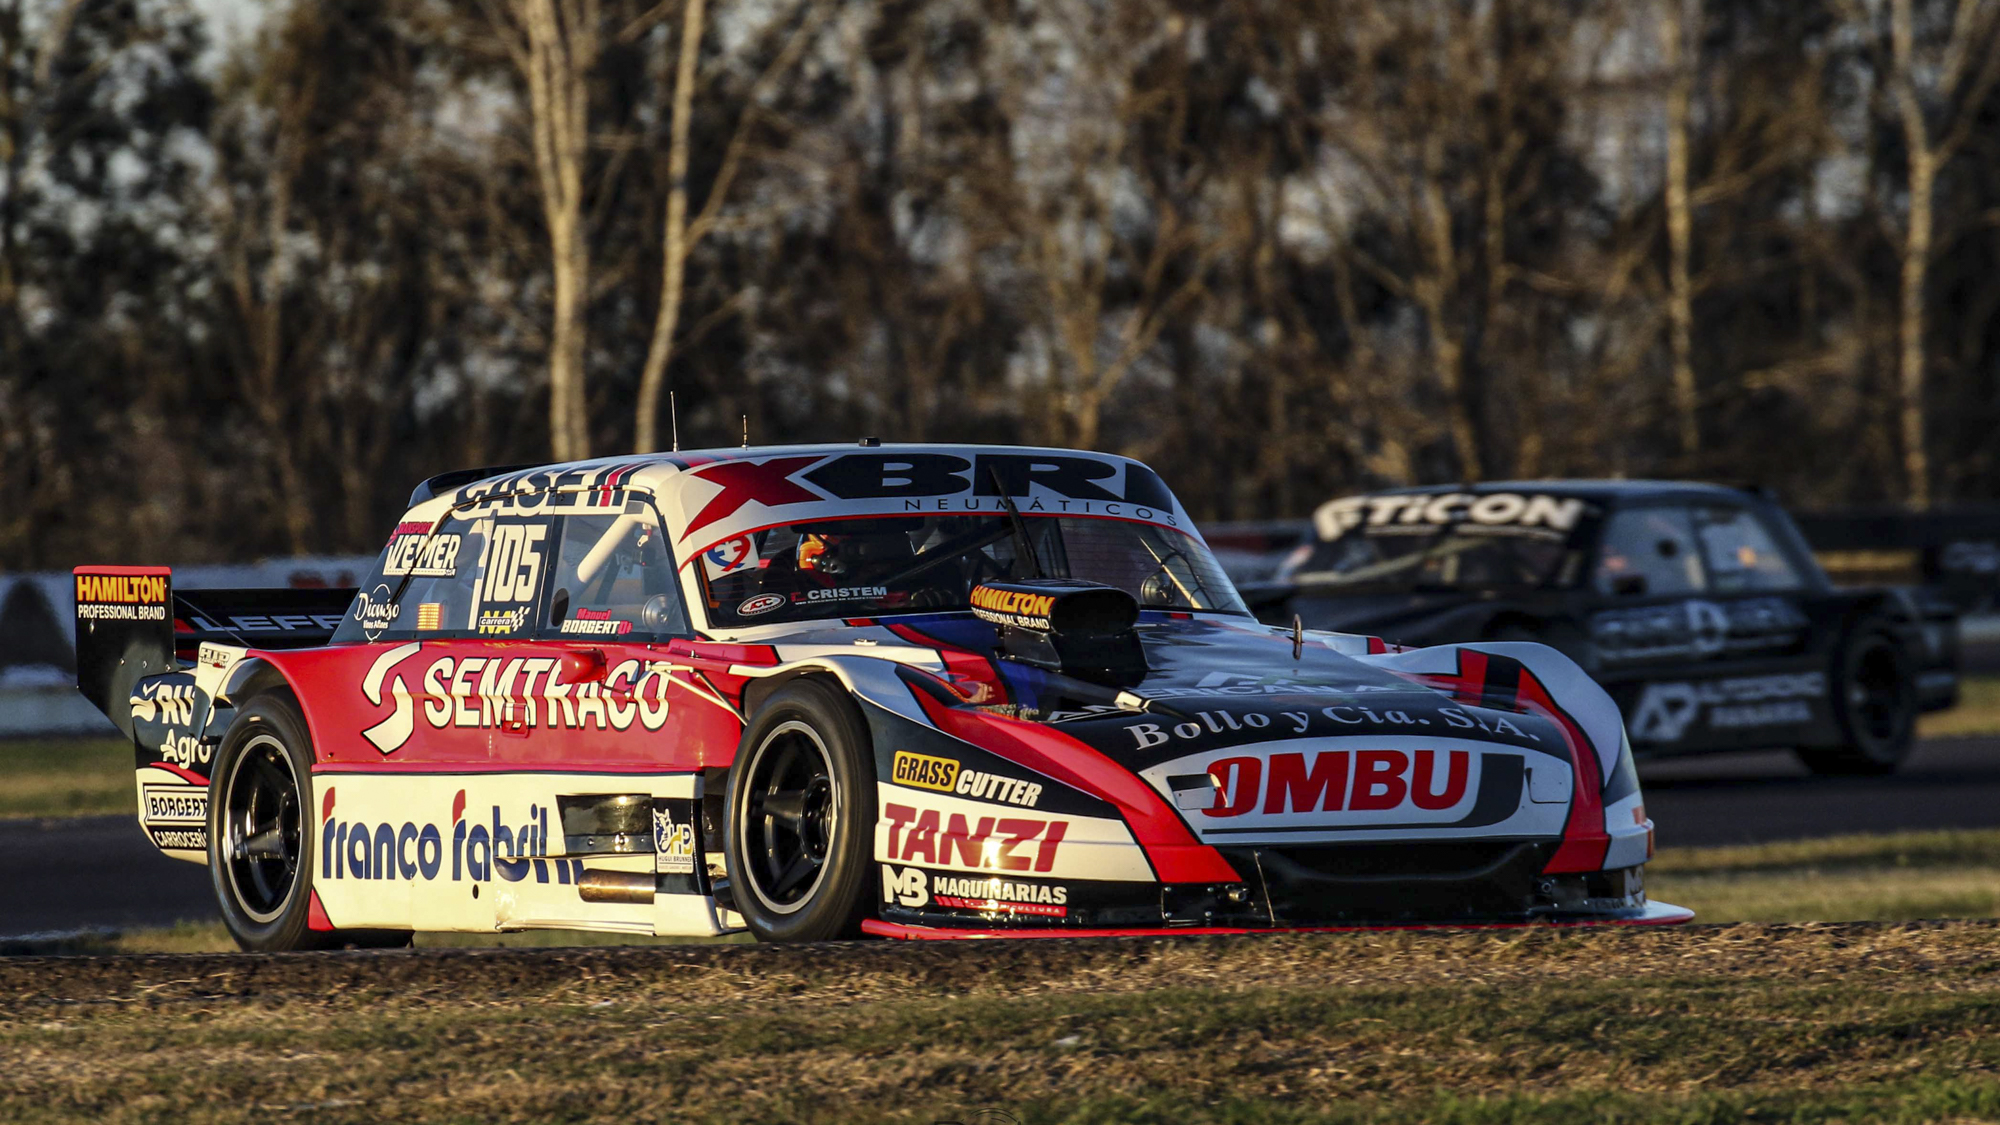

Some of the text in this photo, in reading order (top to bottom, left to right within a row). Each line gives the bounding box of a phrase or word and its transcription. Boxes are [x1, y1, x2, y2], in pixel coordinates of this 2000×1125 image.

[680, 452, 1173, 541] XBRI
[905, 496, 1178, 527] NEUMÁTICOS
[483, 524, 548, 602] 105
[77, 575, 165, 604] HAMILTON
[807, 586, 887, 601] CRISTEM
[970, 584, 1056, 616] HAMILTON
[78, 604, 165, 620] PROFESSIONAL BRAND
[481, 617, 510, 625] carrera
[576, 608, 612, 620] Manuel
[1017, 615, 1050, 630] BRAND
[423, 656, 672, 731] SEMTRACO
[1123, 705, 1541, 751] Bollo y Cia. S.A.
[896, 755, 1043, 807] GRASS CUTTER
[1201, 749, 1469, 818] OMBU
[322, 786, 442, 881] franco
[884, 802, 1070, 873] TANZI
[882, 864, 929, 908] MB
[933, 876, 1067, 905] MAQUINARIAS
